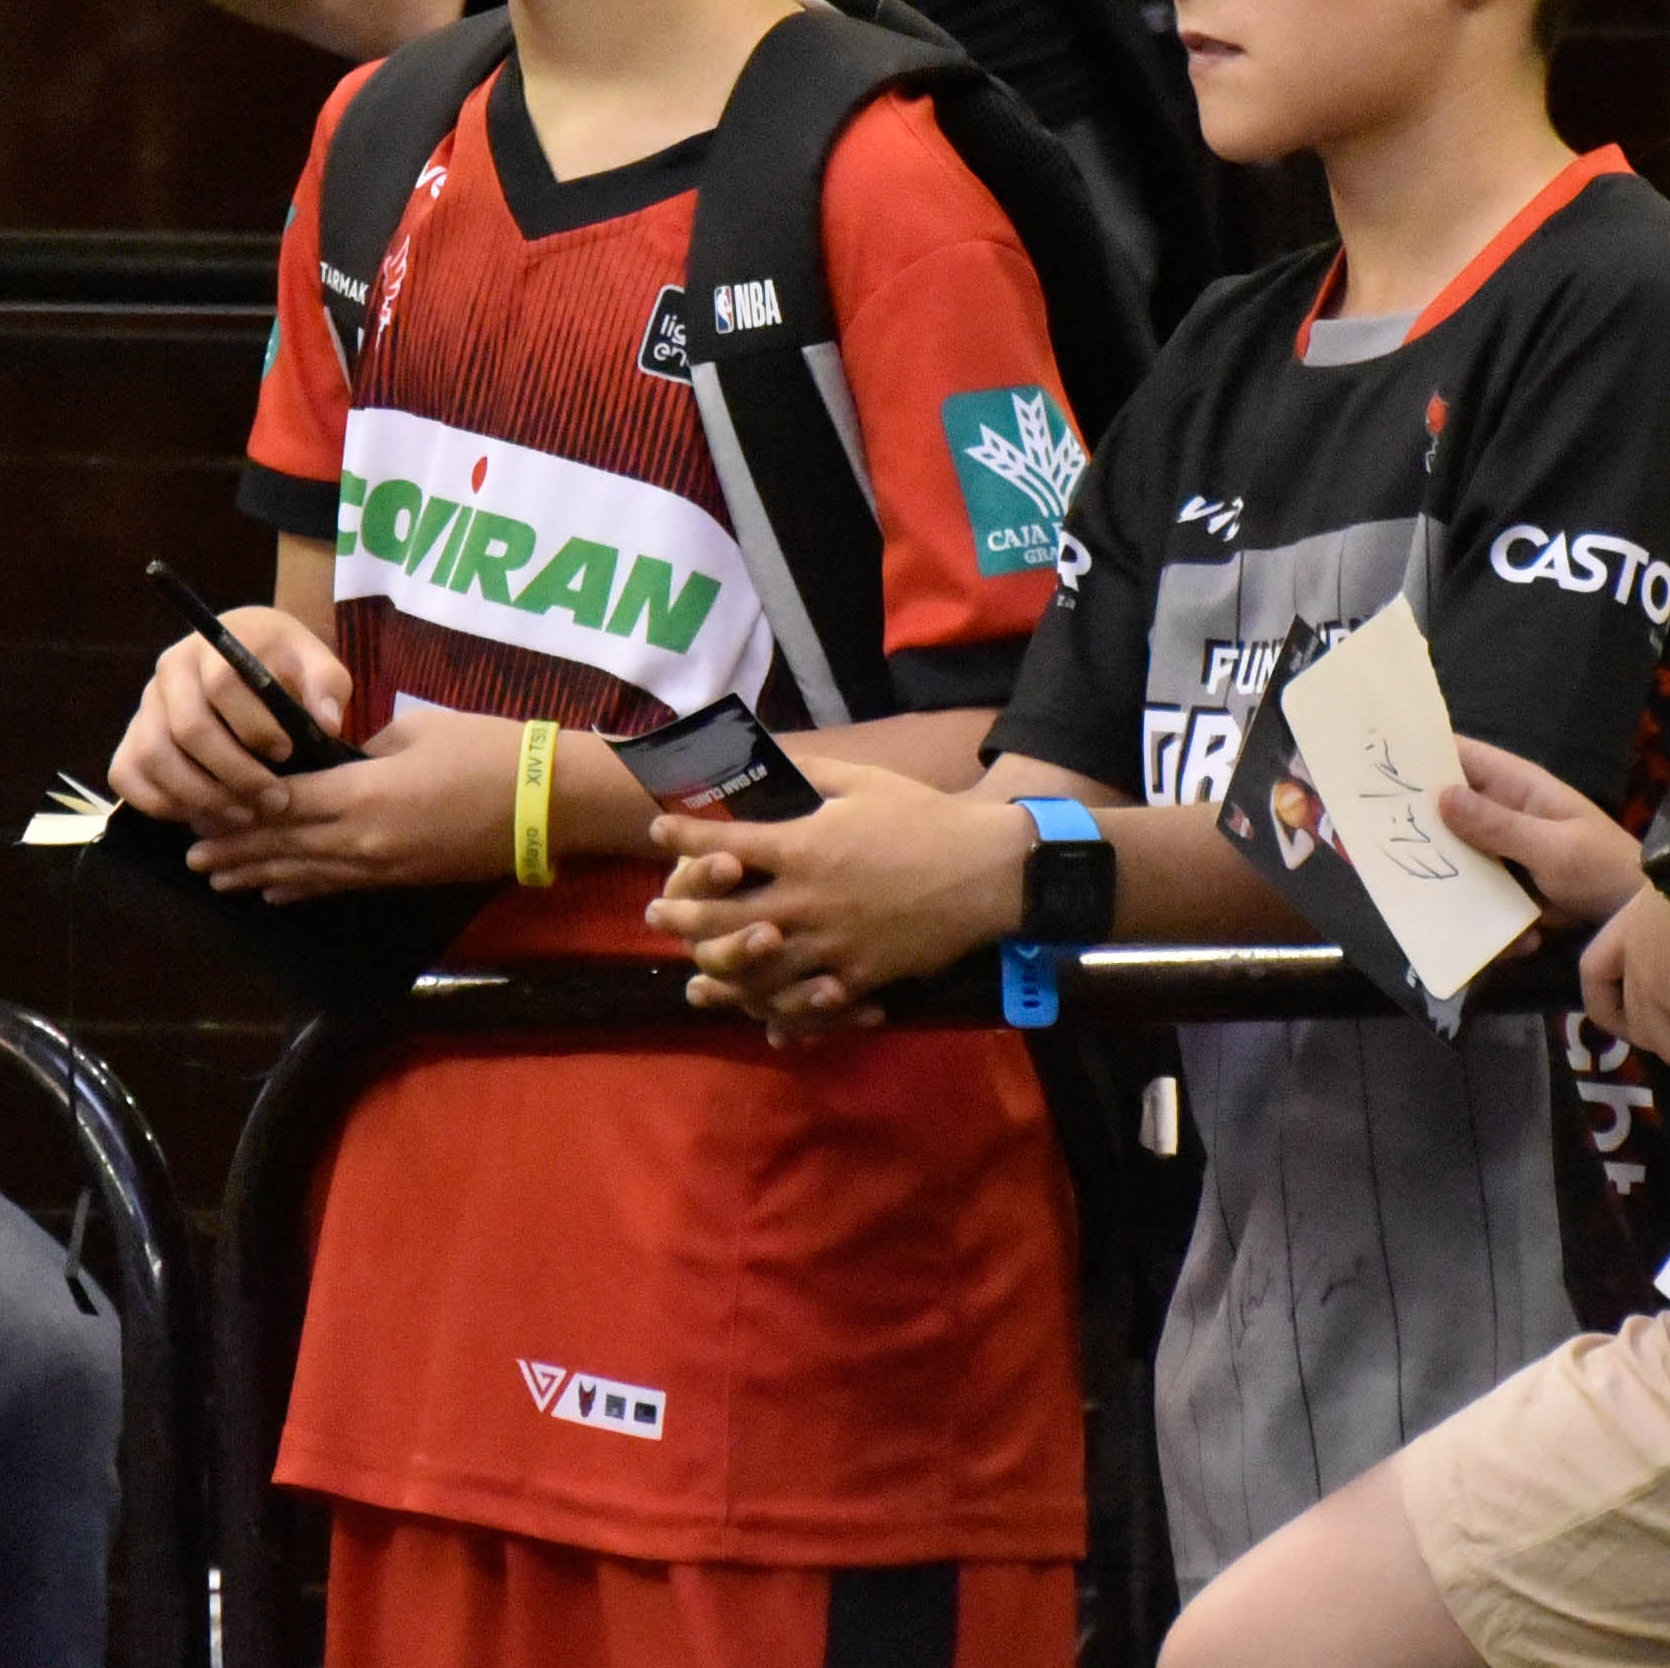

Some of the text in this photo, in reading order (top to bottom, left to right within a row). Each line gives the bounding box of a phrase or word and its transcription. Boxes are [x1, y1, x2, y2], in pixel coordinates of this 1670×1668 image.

[320, 261, 370, 305] TARMAK
[733, 279, 783, 330] NBA
[660, 314, 687, 347] lig
[987, 523, 1051, 552] CAJA
